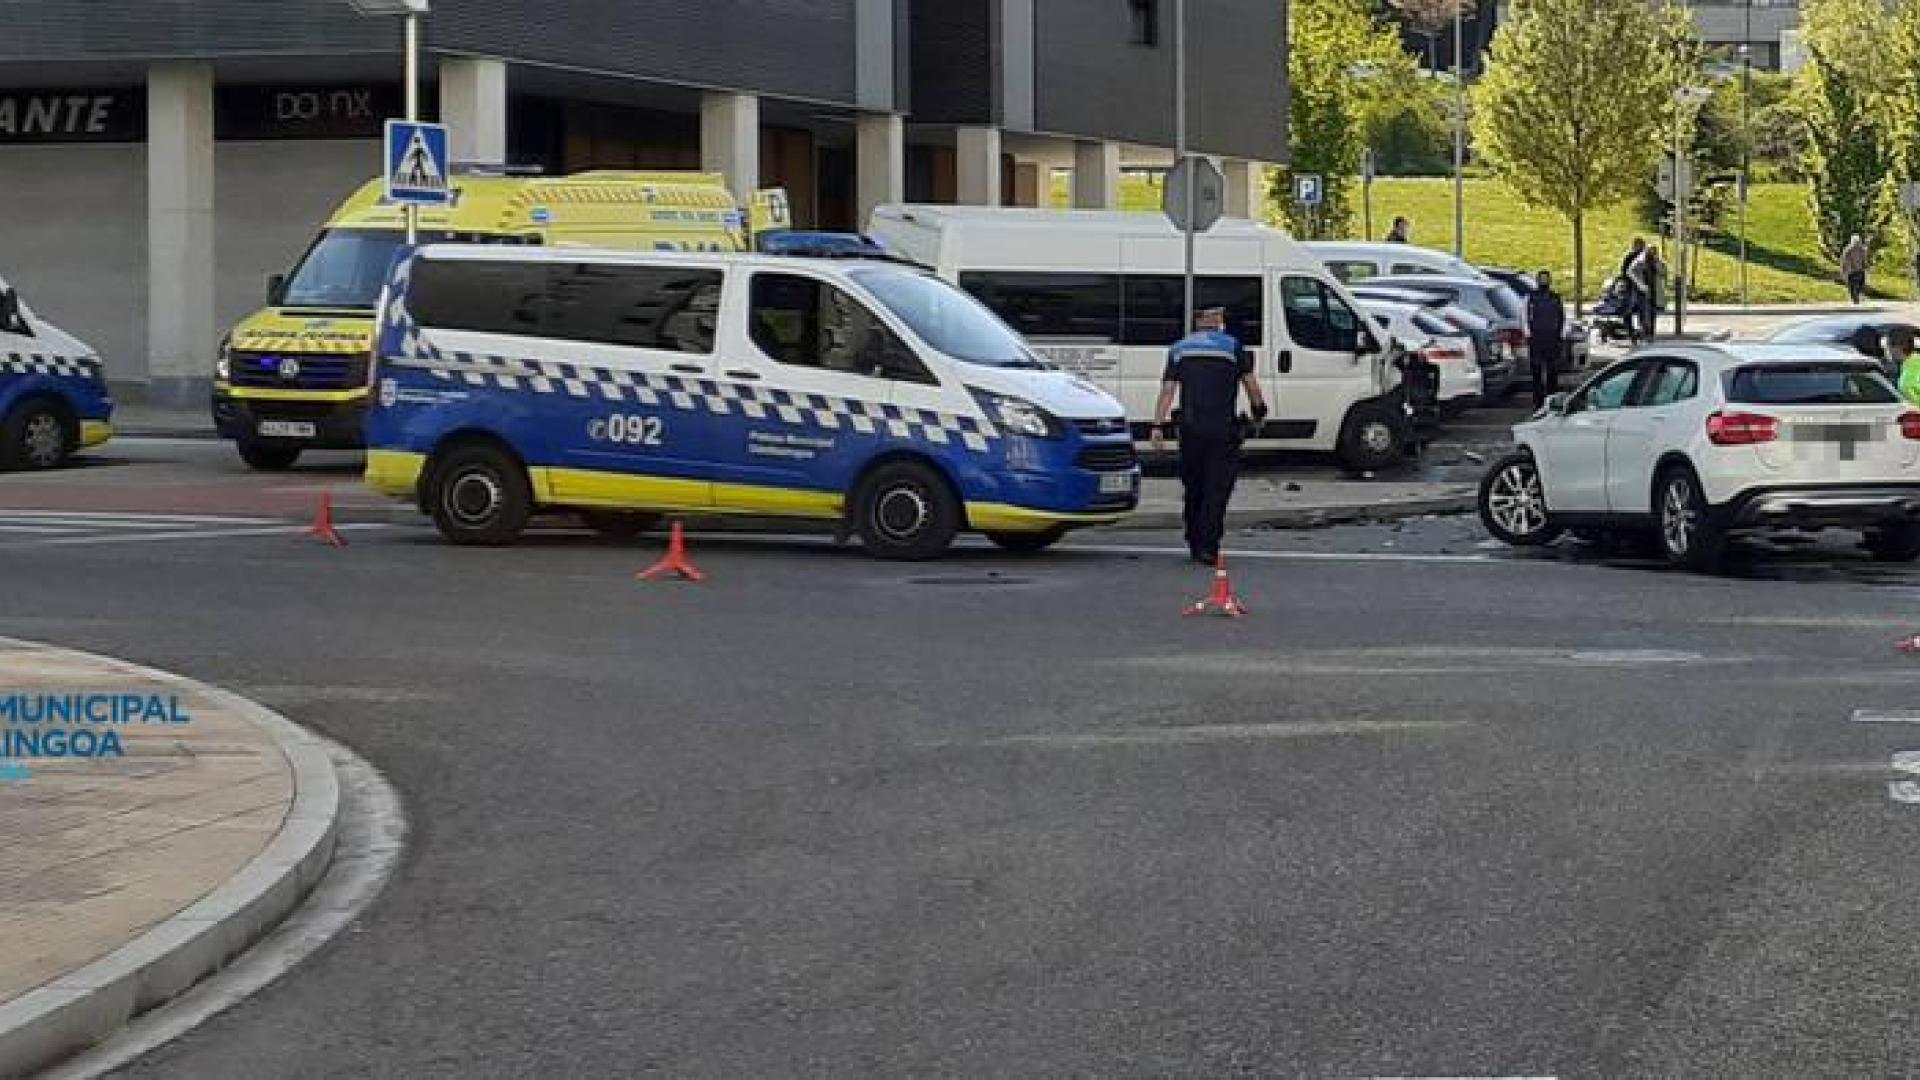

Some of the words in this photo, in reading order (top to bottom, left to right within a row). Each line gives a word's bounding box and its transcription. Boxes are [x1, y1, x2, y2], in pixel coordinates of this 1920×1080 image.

[0, 96, 114, 132] ANTE
[1300, 181, 1315, 199] P
[607, 413, 662, 444] 092
